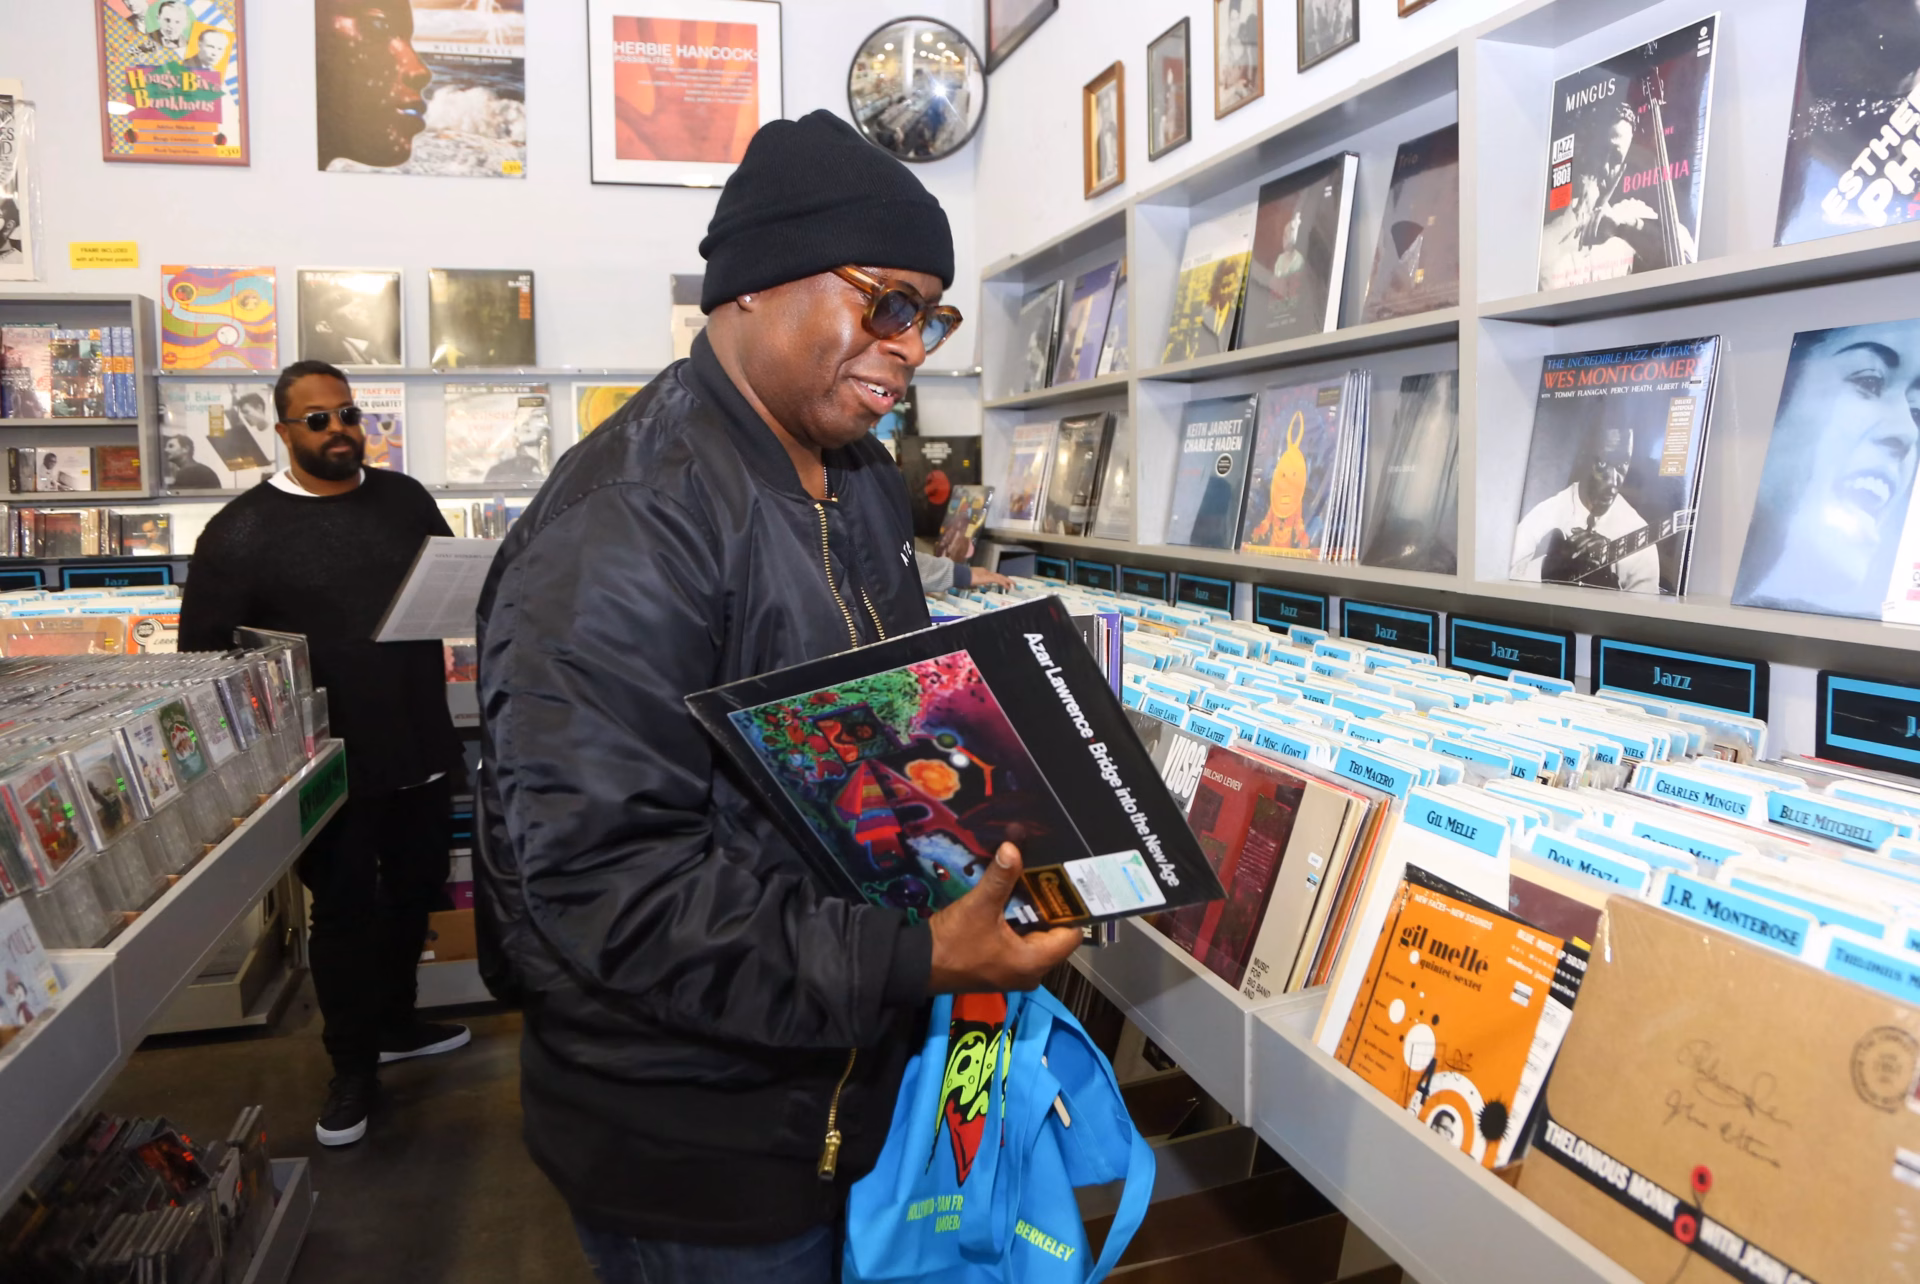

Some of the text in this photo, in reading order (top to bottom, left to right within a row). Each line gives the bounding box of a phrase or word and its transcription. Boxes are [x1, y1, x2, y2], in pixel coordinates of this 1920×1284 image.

[614, 41, 758, 61] HERBIE HANCOCK:
[614, 55, 674, 64] POSSIBILITIES
[182, 72, 210, 91] Bix
[1566, 78, 1616, 112] MINGUS
[1554, 137, 1573, 162] JAZZ
[1553, 169, 1566, 188] 180
[1623, 160, 1690, 193] BOHEMIA
[1547, 359, 1565, 370] THE
[1568, 352, 1622, 368] INCREDIBLE
[1623, 349, 1648, 365] JAZZ
[1651, 345, 1690, 359] GUITAR
[1544, 370, 1576, 389] WES
[362, 388, 402, 396] TAKE FIVE
[493, 386, 531, 394] DAVIS
[1554, 391, 1576, 399] TOMMY
[1611, 386, 1630, 394] PERCY
[1656, 382, 1679, 391] ALBERT
[1187, 420, 1243, 438] KEITH JARRETT
[1184, 436, 1243, 453] CHARLIE HADEN
[104, 577, 129, 586] Jazz
[1195, 587, 1209, 600] Jazz
[1280, 603, 1298, 618] Jazz
[1375, 623, 1397, 640] Jazz
[1491, 641, 1520, 661] Jazz
[1653, 666, 1692, 690] Jazz
[1148, 703, 1178, 723] ELOISE LAWS
[1190, 721, 1225, 743] YUSEF LATEEF
[1256, 734, 1261, 745] L
[1023, 632, 1180, 887] Azar Lawrence Bridge into the New Age
[1203, 768, 1243, 791] MILCHO LEVIEV
[1349, 760, 1395, 789] TEO MACERO
[1656, 779, 1747, 816] CHARLES MINGUS
[1427, 810, 1478, 840] GIL MELLE
[1779, 805, 1873, 844] BLUE MITCHELL
[1547, 848, 1620, 884] DON MENZA
[1465, 913, 1493, 930] SOUNDS
[1663, 885, 1799, 947] J.R. MONTEROSE
[1398, 924, 1429, 951] gil
[1536, 939, 1556, 955] NOTE
[1250, 967, 1262, 979] FOR
[1253, 957, 1271, 974] MUSIC
[1420, 958, 1452, 978] quintet
[1243, 987, 1256, 1000] AND
[1246, 977, 1271, 998] BIG BAND
[1544, 1119, 1630, 1190] THELONIOUS
[1627, 1173, 1679, 1222] MONK
[1699, 1216, 1745, 1262] WITH
[1015, 1218, 1075, 1262] BERKELEY
